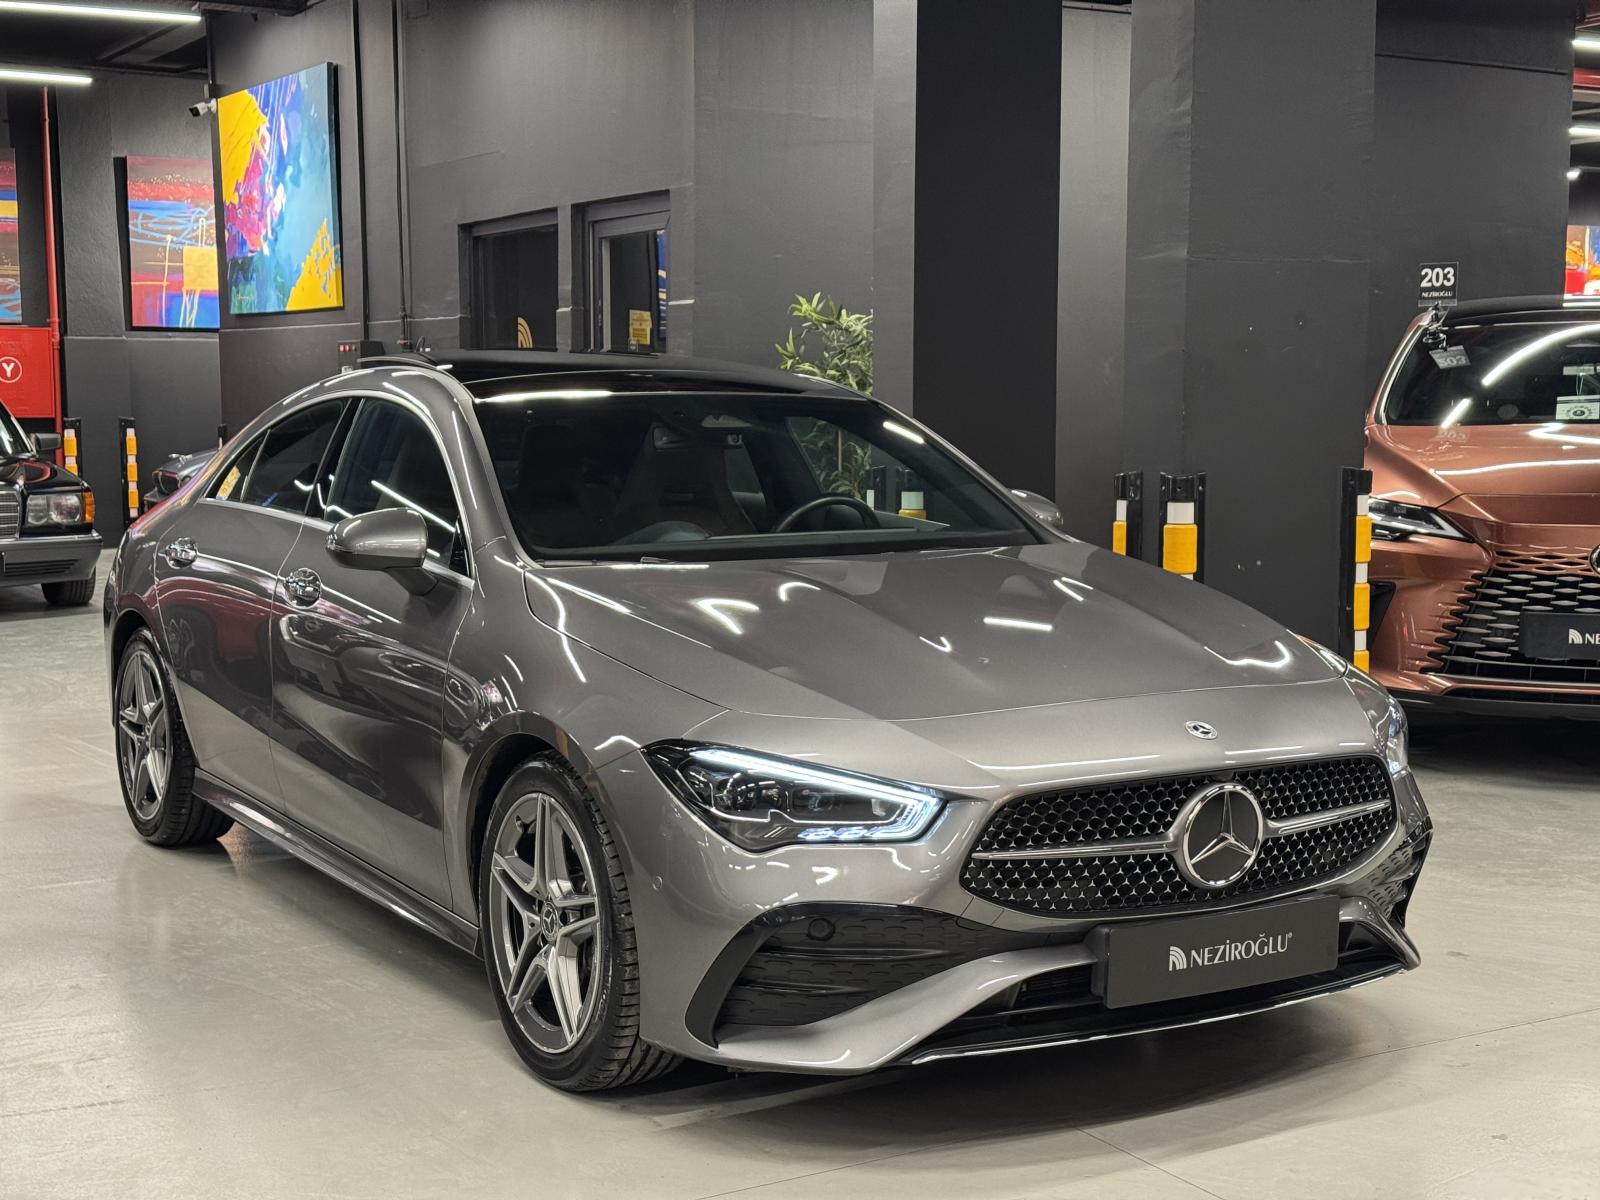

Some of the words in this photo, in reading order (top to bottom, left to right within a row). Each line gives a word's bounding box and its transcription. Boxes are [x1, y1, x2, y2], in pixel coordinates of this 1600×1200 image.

[1420, 267, 1455, 287] 203
[1, 362, 15, 378] Y
[1190, 932, 1288, 968] NEZİROĞLU
